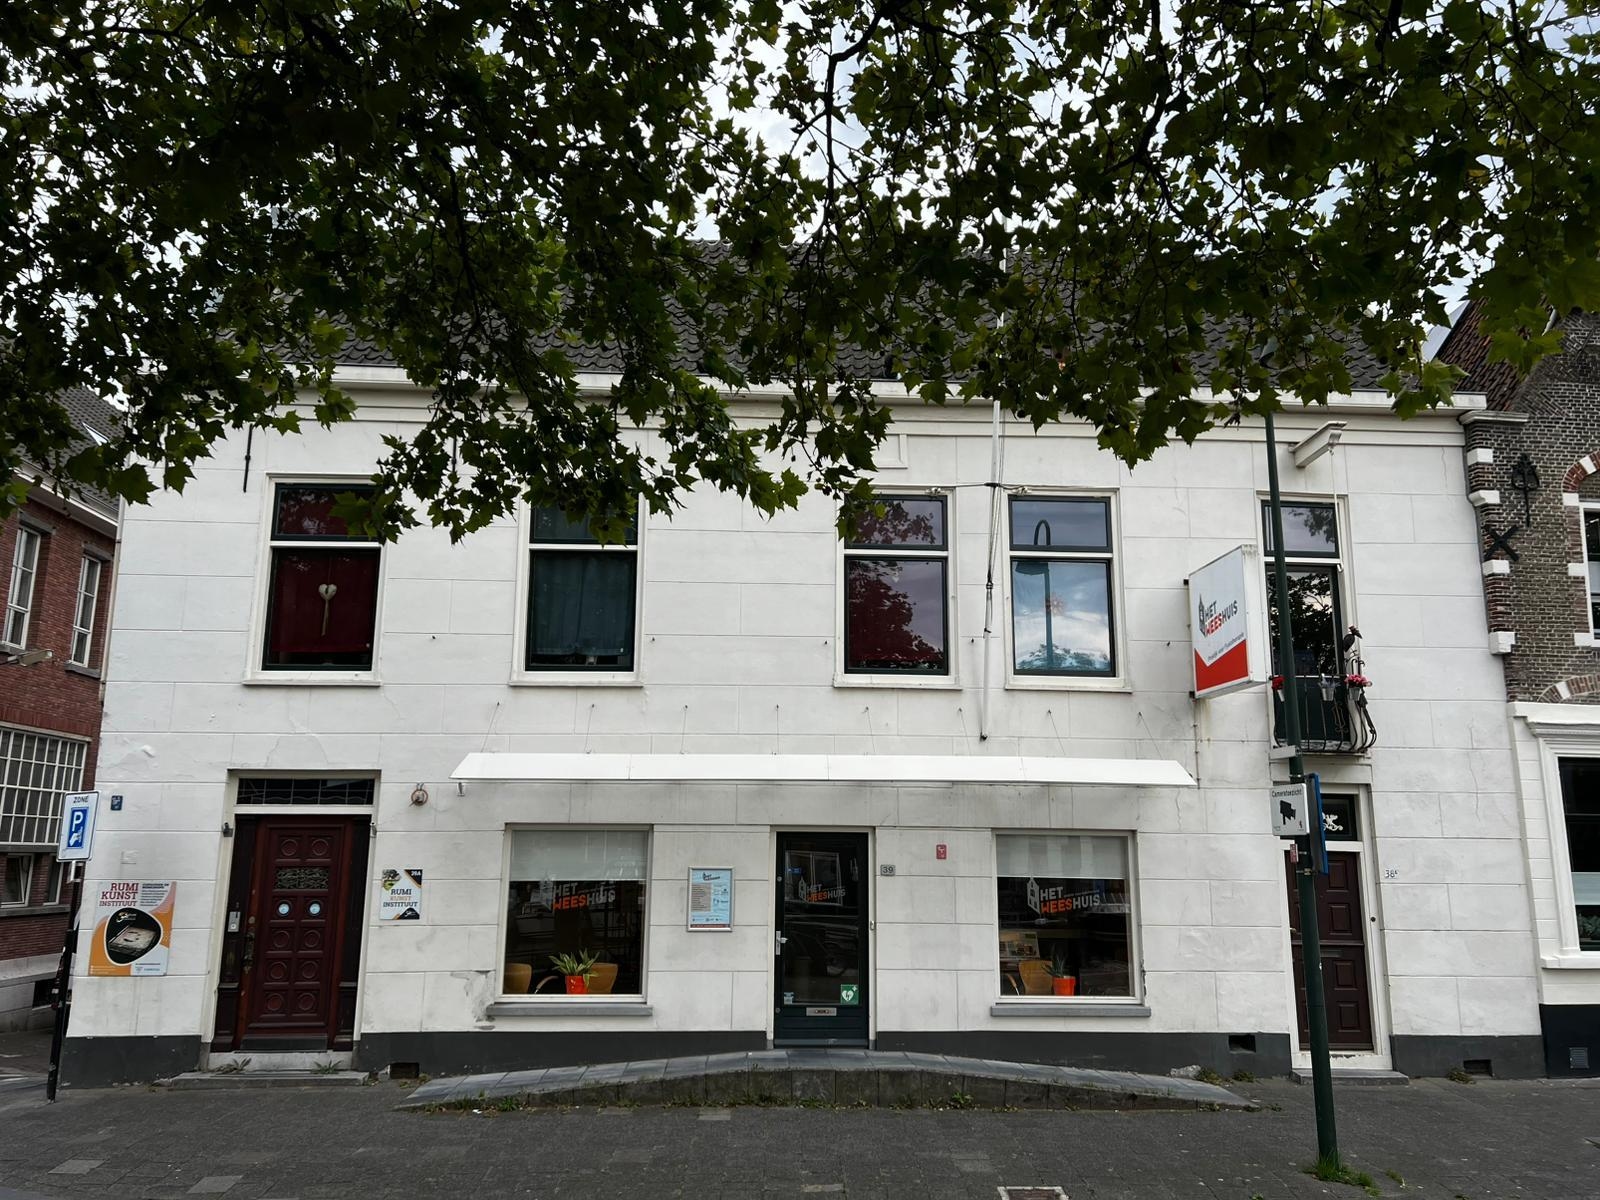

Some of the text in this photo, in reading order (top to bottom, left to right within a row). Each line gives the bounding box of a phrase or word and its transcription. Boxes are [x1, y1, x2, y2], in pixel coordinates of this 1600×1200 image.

[1205, 600, 1217, 622] HET
[1206, 600, 1238, 635] WEESHUIS
[73, 795, 89, 803] ZONE
[1271, 788, 1303, 797] Cameratoezicht
[110, 882, 139, 891] RUMI
[553, 882, 578, 897] HET
[806, 883, 822, 893] HET
[1040, 886, 1063, 900] HET
[101, 891, 138, 900] KUNST
[553, 889, 616, 910] WEESHUIS
[807, 889, 846, 902] WEESHUIS
[1041, 894, 1100, 913] WEESHUIS
